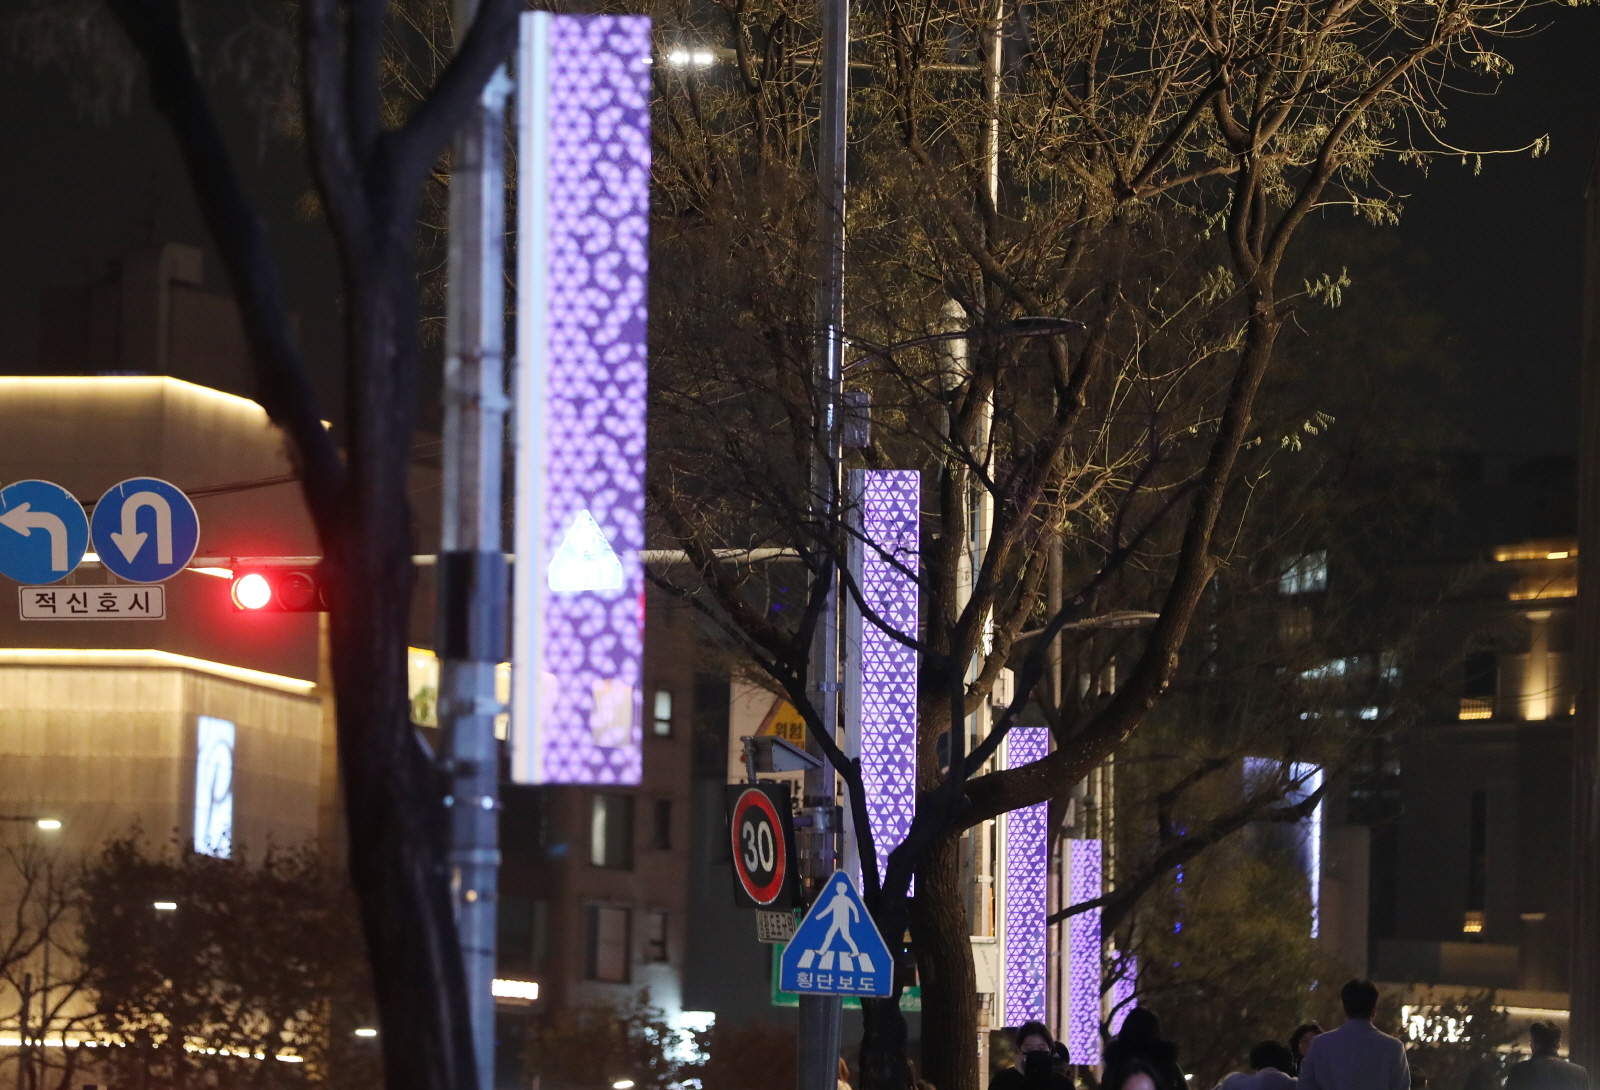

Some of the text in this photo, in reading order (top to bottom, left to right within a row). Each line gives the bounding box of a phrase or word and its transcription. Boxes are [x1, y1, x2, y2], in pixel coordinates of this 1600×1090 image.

[35, 591, 150, 614] 적신호시
[742, 820, 774, 873] 30
[796, 971, 876, 992] 횡단보도
